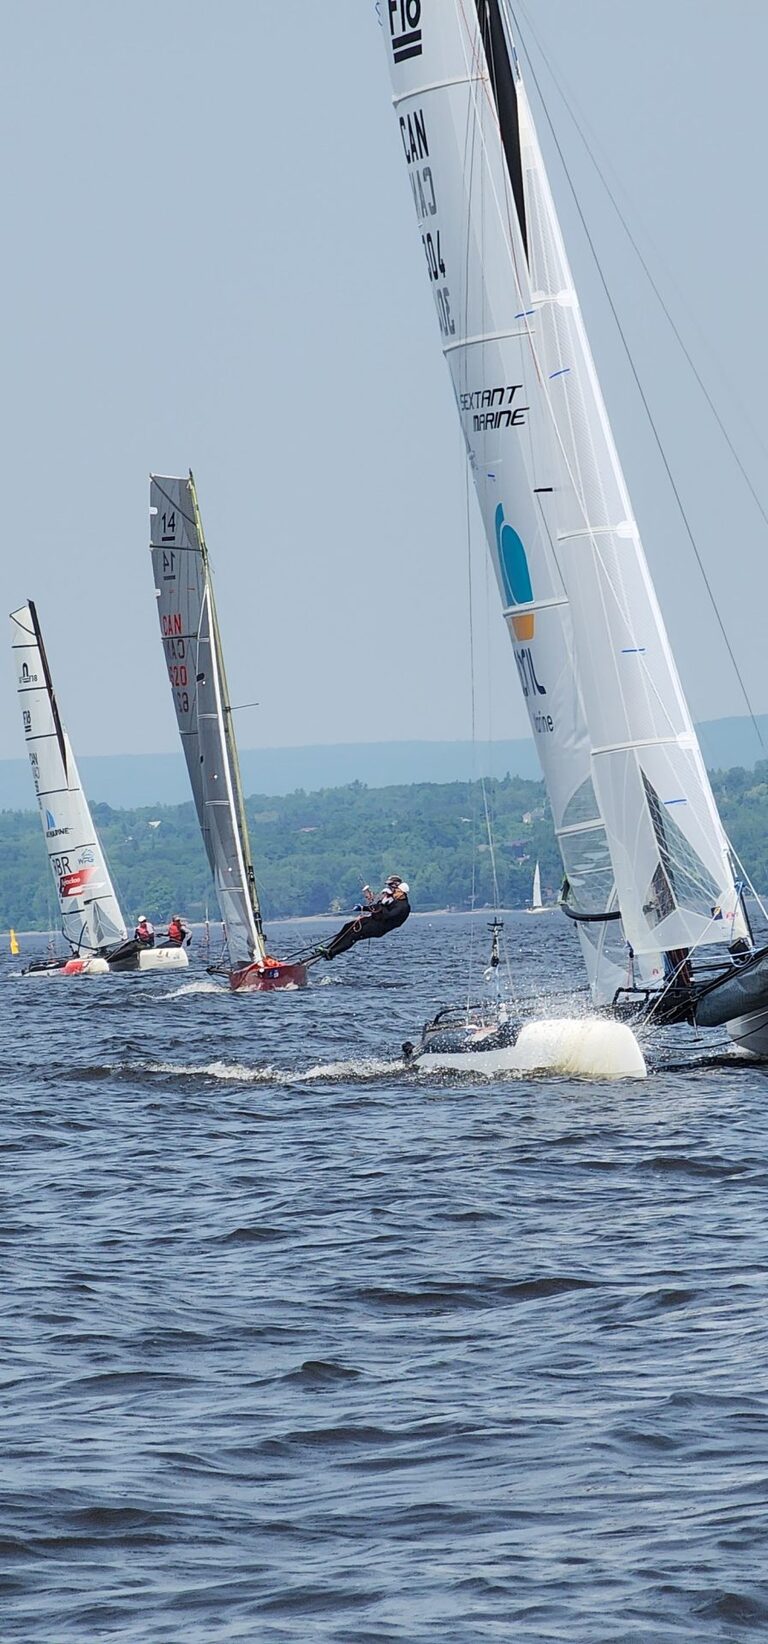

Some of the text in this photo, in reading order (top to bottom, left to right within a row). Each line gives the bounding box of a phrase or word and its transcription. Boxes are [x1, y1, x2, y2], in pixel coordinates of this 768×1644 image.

[399, 109, 429, 164] CAN
[460, 385, 523, 411] SEXTANT
[473, 407, 530, 432] MARINE
[162, 512, 176, 533] 14
[162, 613, 182, 636] CAN
